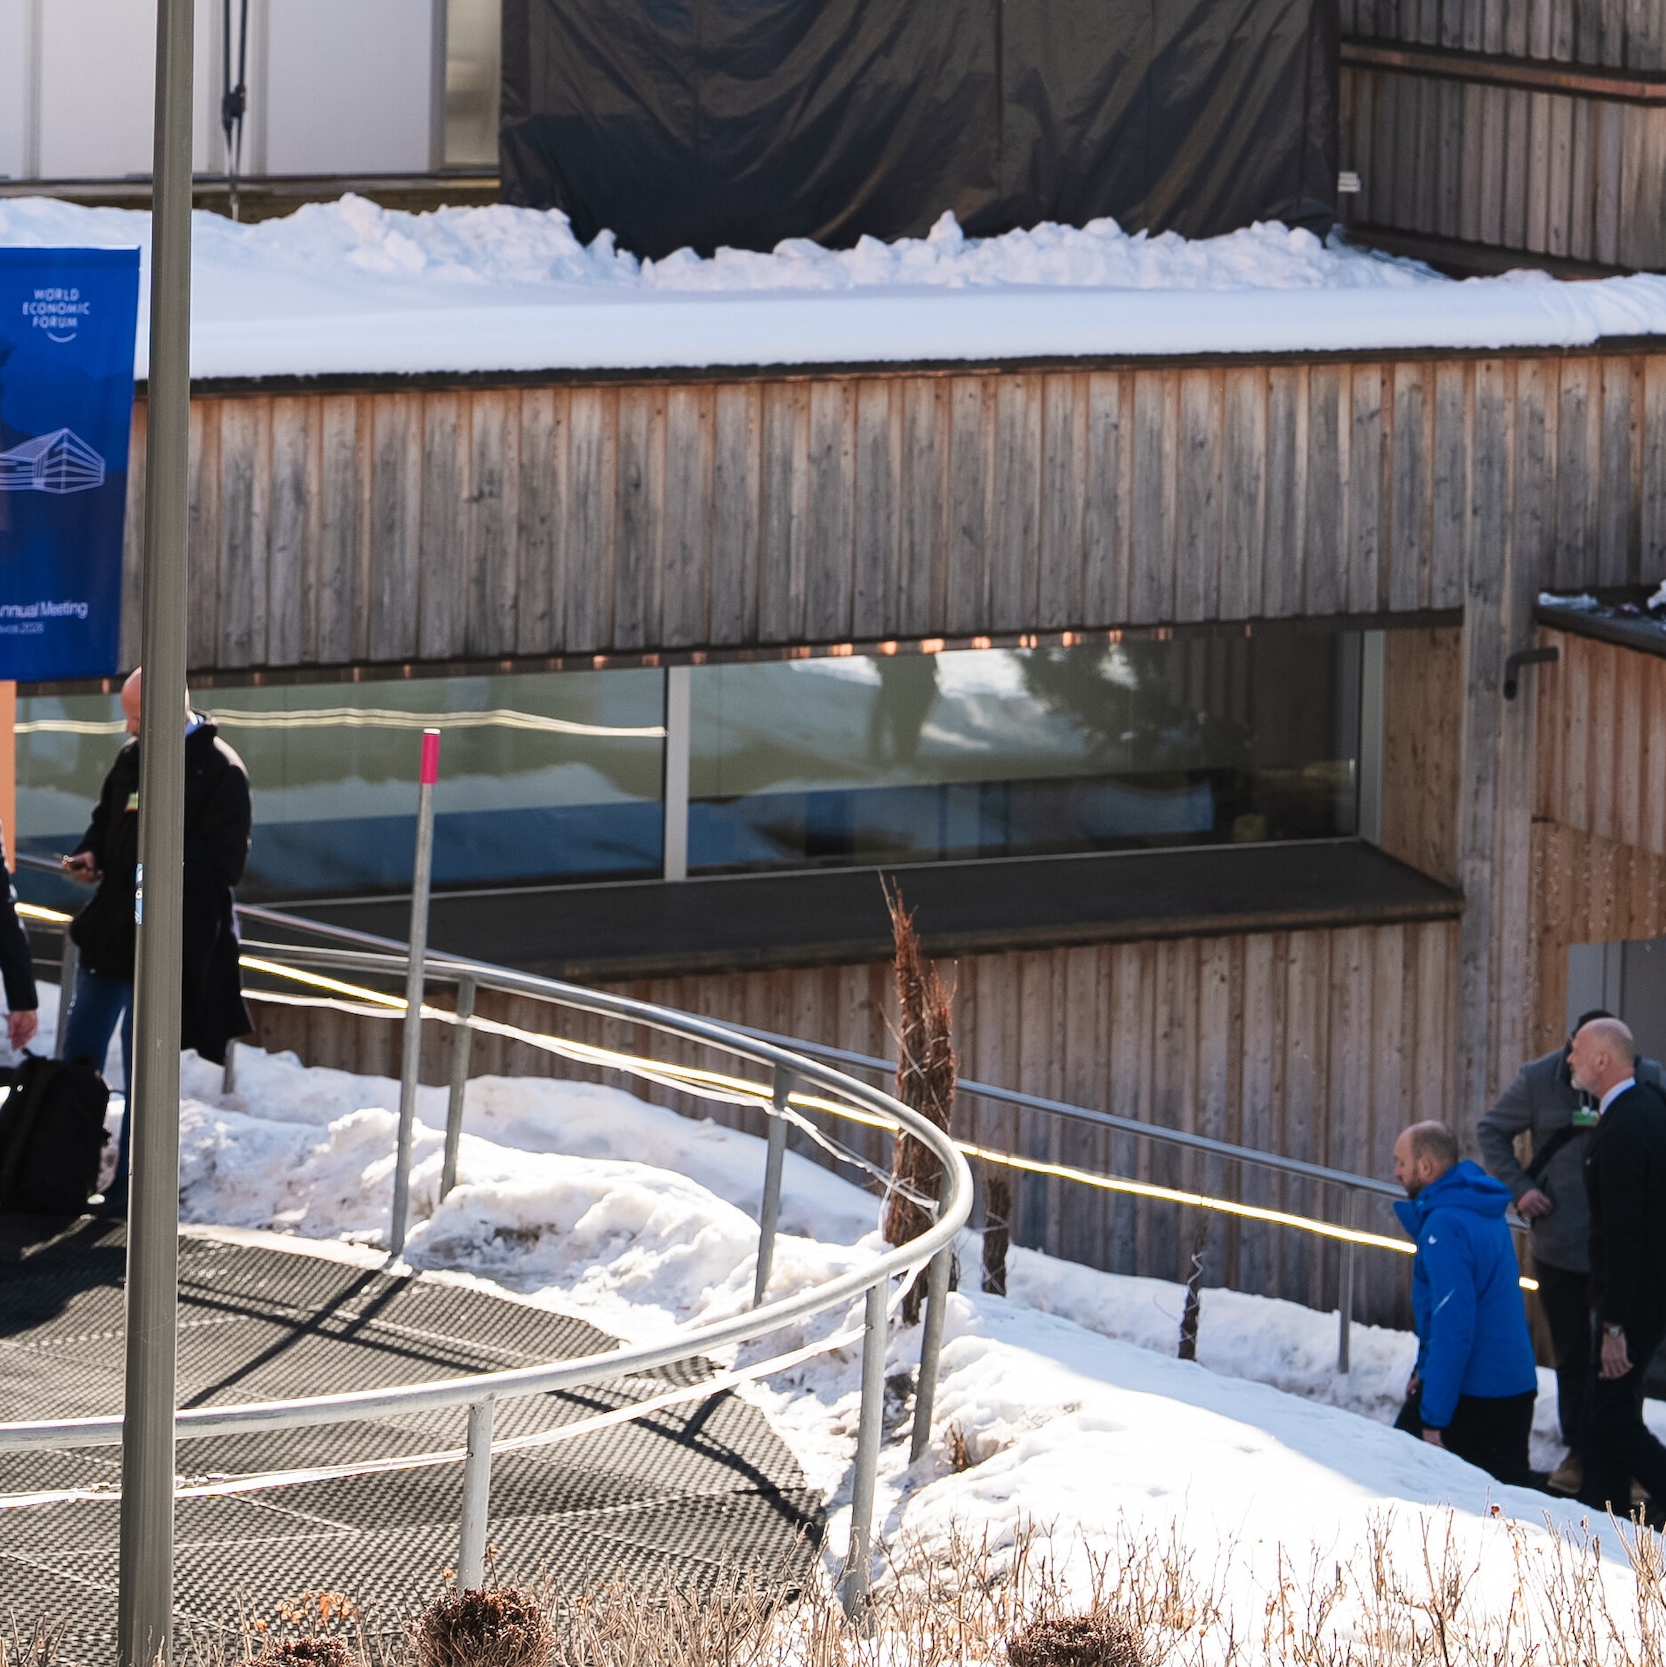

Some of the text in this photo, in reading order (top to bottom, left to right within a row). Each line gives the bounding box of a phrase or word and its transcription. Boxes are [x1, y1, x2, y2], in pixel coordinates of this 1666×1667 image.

[34, 288, 80, 300] WORLD
[22, 301, 90, 315] ECONOMIC
[32, 315, 78, 328] FORUM
[40, 600, 89, 620] Meeting
